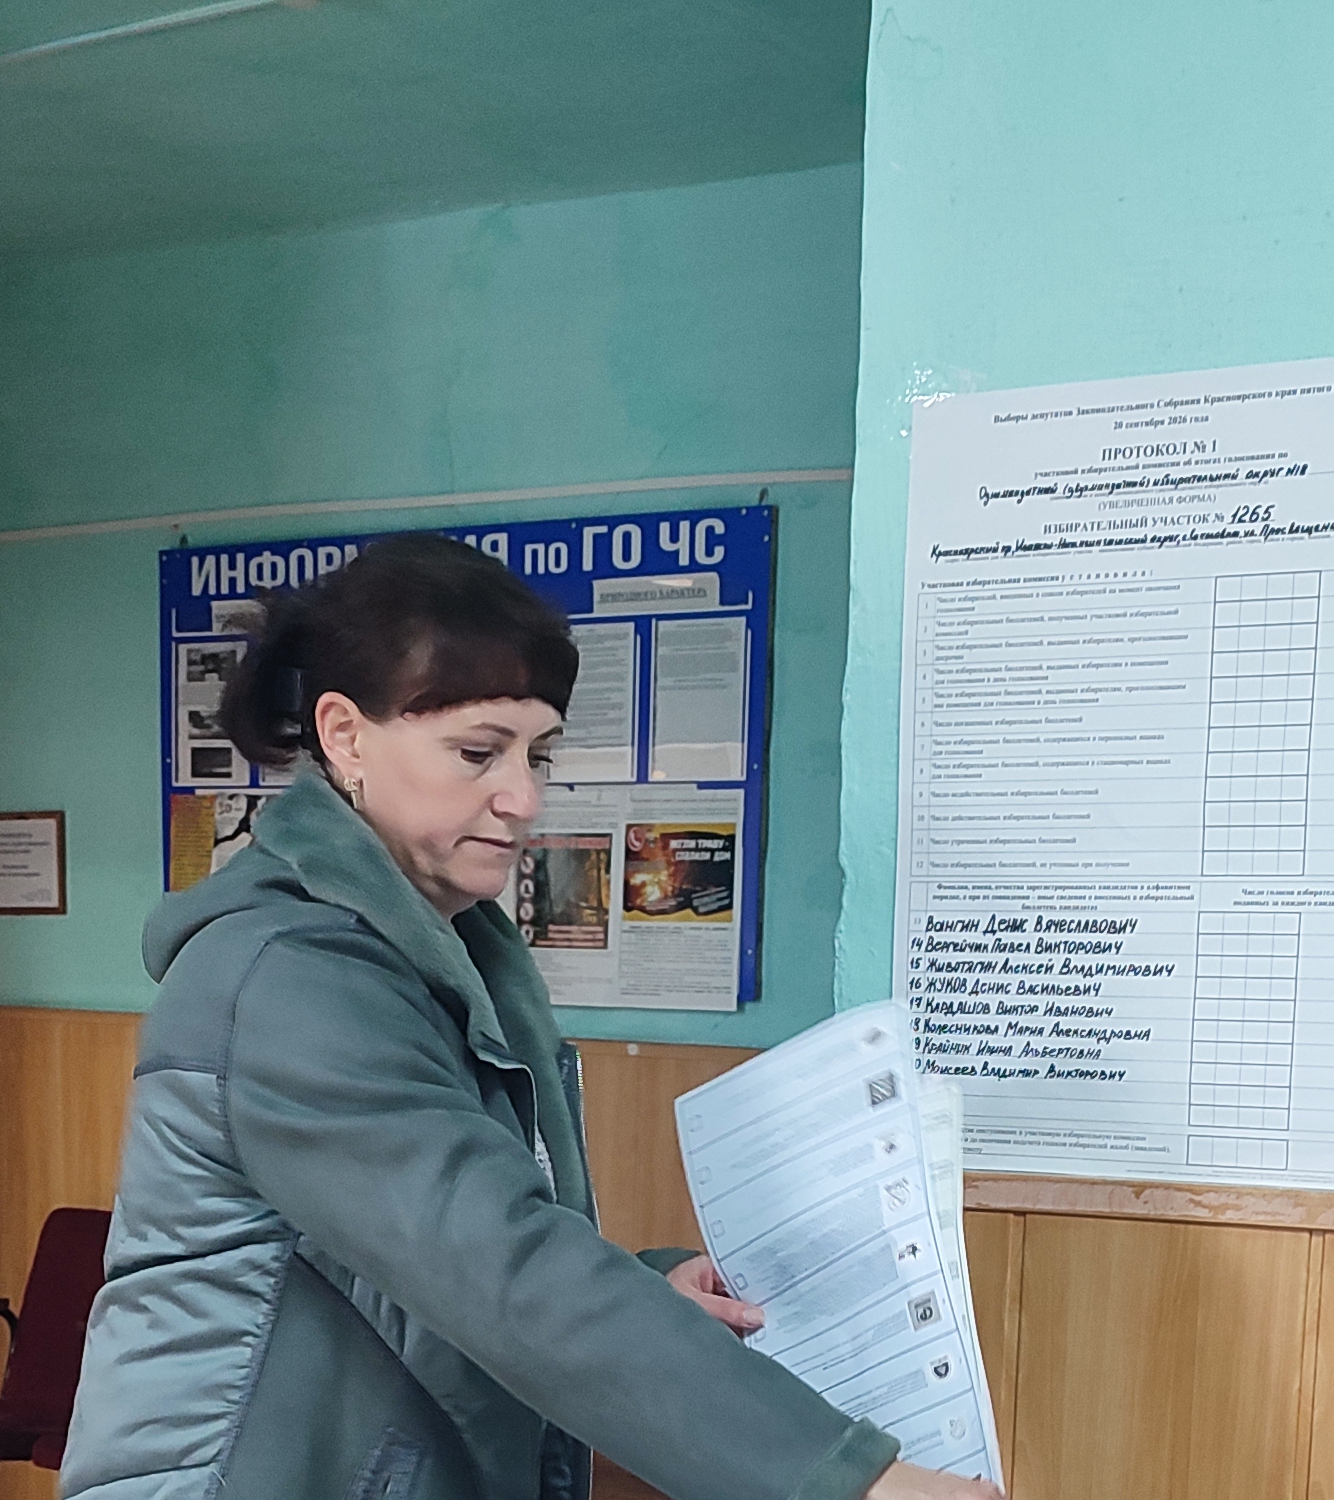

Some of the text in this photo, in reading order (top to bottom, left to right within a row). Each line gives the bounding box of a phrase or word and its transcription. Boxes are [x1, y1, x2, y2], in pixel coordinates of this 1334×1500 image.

[1102, 439, 1217, 462] ПРОТОКОЛ № 1
[1175, 493, 1217, 506] ФОРМА)
[1043, 512, 1225, 535] ИЗБИРАТЕЛЬНЫЙ УЧАСТОК №
[1230, 504, 1276, 525] 1265
[583, 522, 644, 572] ГО
[659, 518, 726, 567] ЧС
